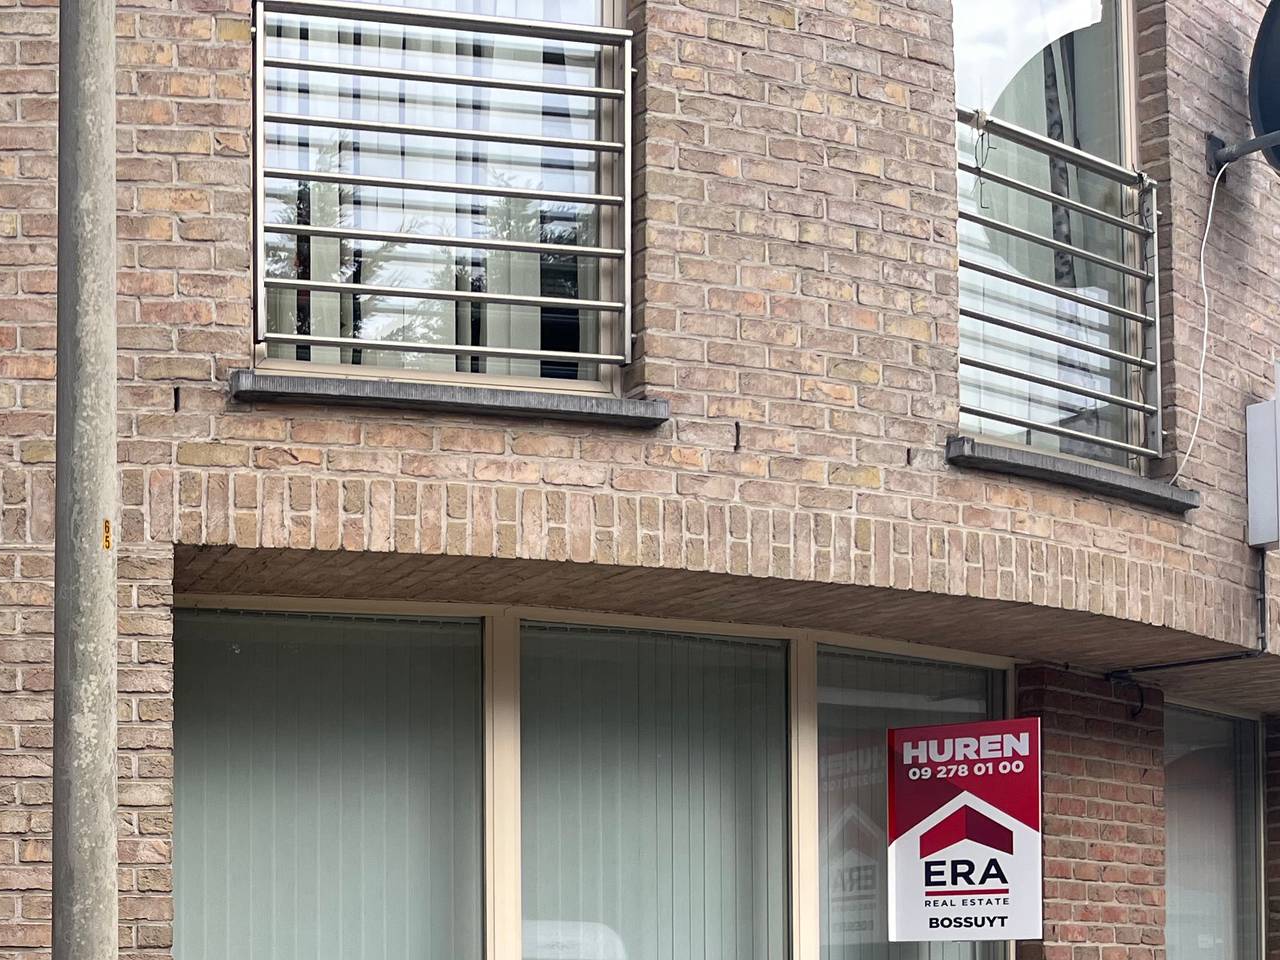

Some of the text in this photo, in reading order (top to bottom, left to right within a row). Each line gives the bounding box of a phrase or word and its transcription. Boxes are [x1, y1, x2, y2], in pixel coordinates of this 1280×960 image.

[104, 519, 110, 550] 65
[903, 732, 1030, 764] HUREN
[908, 760, 1024, 780] 09 278 01 00
[924, 858, 1009, 887] ERA
[924, 897, 1010, 908] REAL ESTATE
[928, 915, 1009, 929] BOSSUYT
